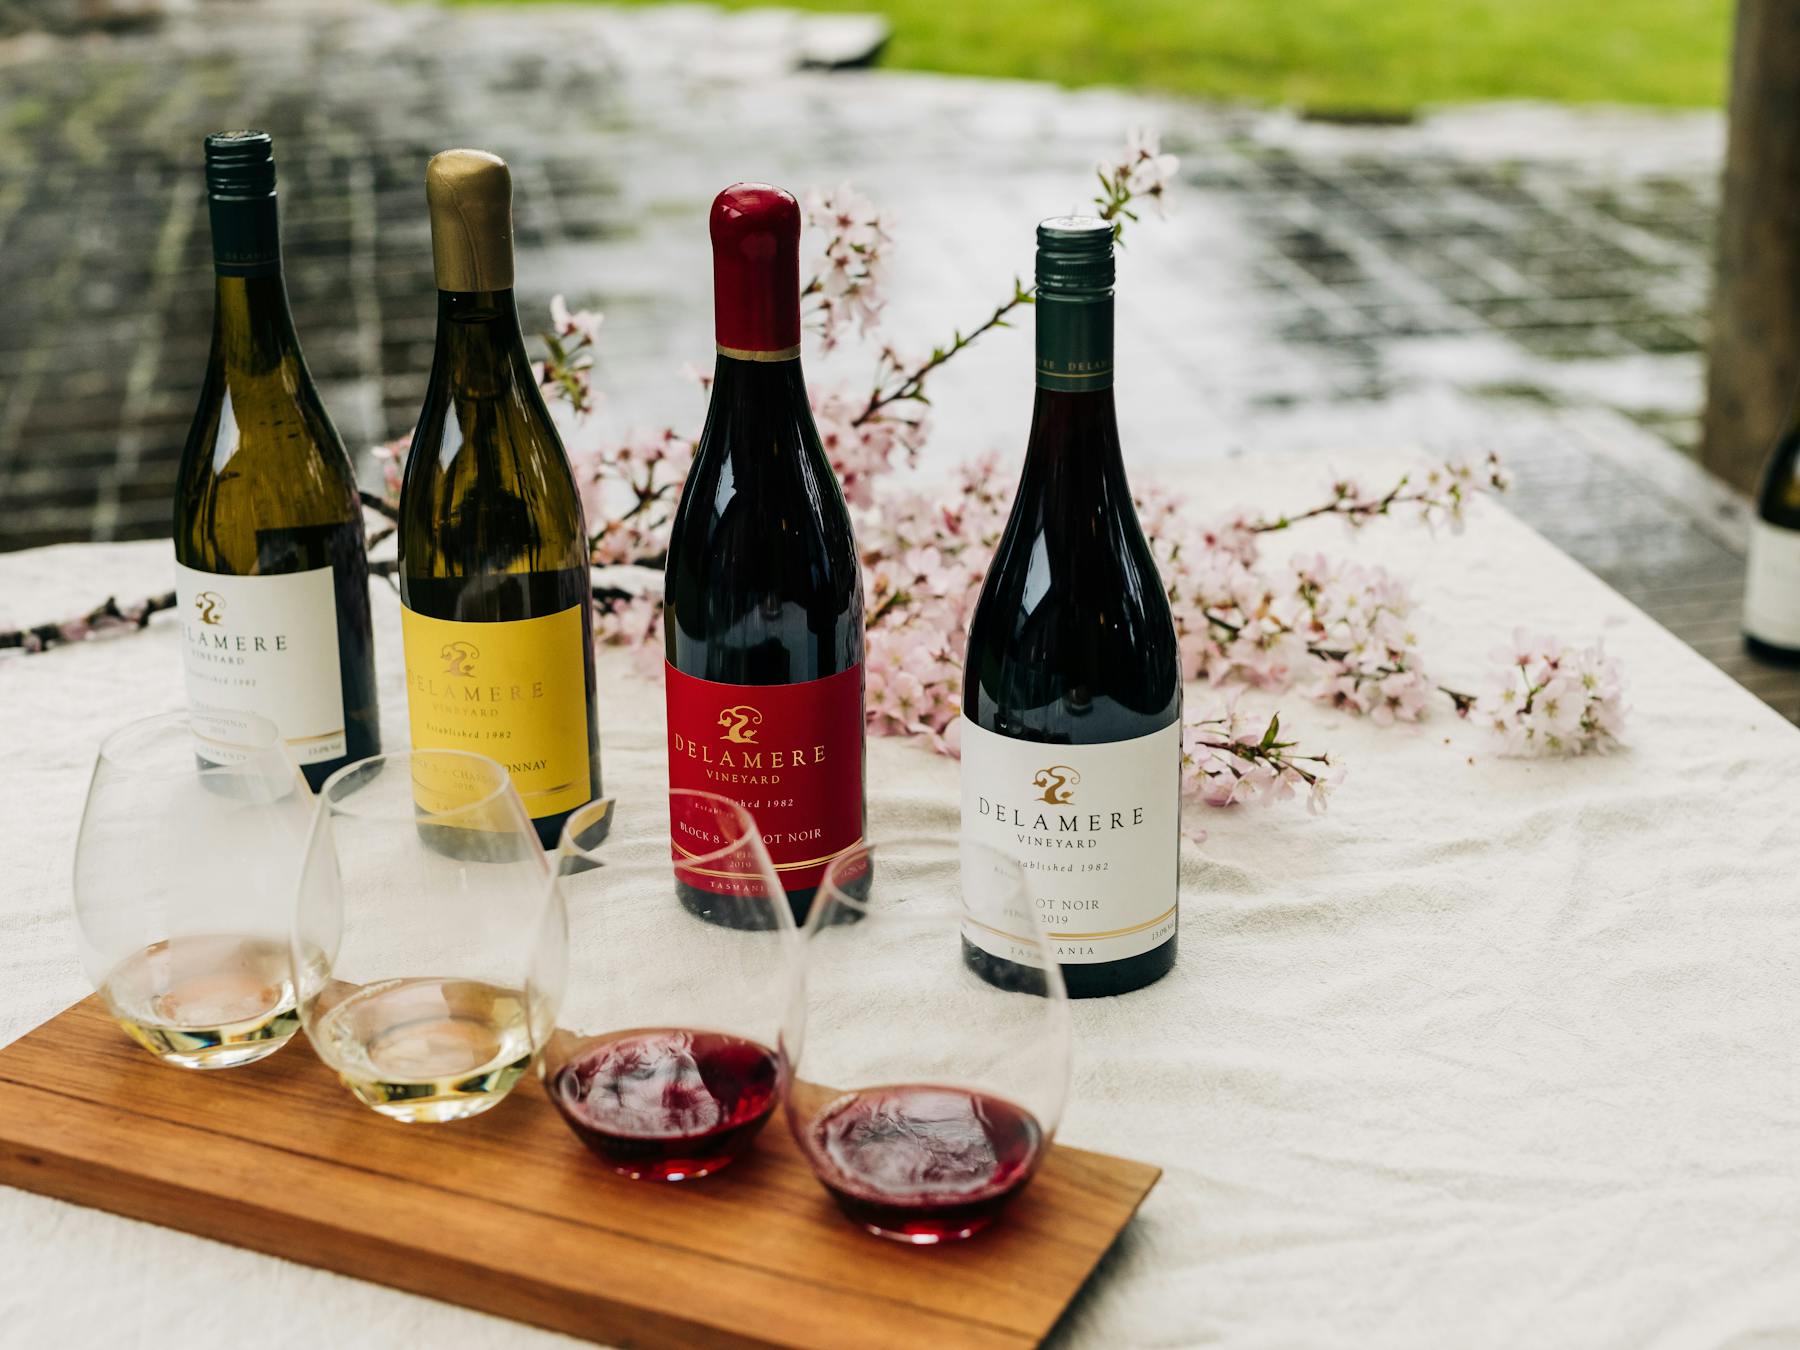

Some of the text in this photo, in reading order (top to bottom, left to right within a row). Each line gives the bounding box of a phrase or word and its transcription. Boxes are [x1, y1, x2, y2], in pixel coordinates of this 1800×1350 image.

[407, 668, 544, 703] DELAMERE
[433, 702, 499, 718] VINEYARD
[485, 730, 512, 740] 1982
[675, 732, 826, 769] DELAMERE
[706, 769, 780, 785] VINEYARD
[767, 799, 794, 808] 1982
[978, 796, 1144, 833] DELAMERE
[679, 820, 710, 842] BLOCK
[713, 833, 721, 845] 8
[788, 827, 822, 844] NOIR
[1017, 834, 1098, 849] VINEYARD
[1080, 862, 1110, 872] 1982
[709, 880, 765, 892] TASMANI
[1062, 899, 1101, 911] NOIR
[1040, 914, 1068, 925] 2019
